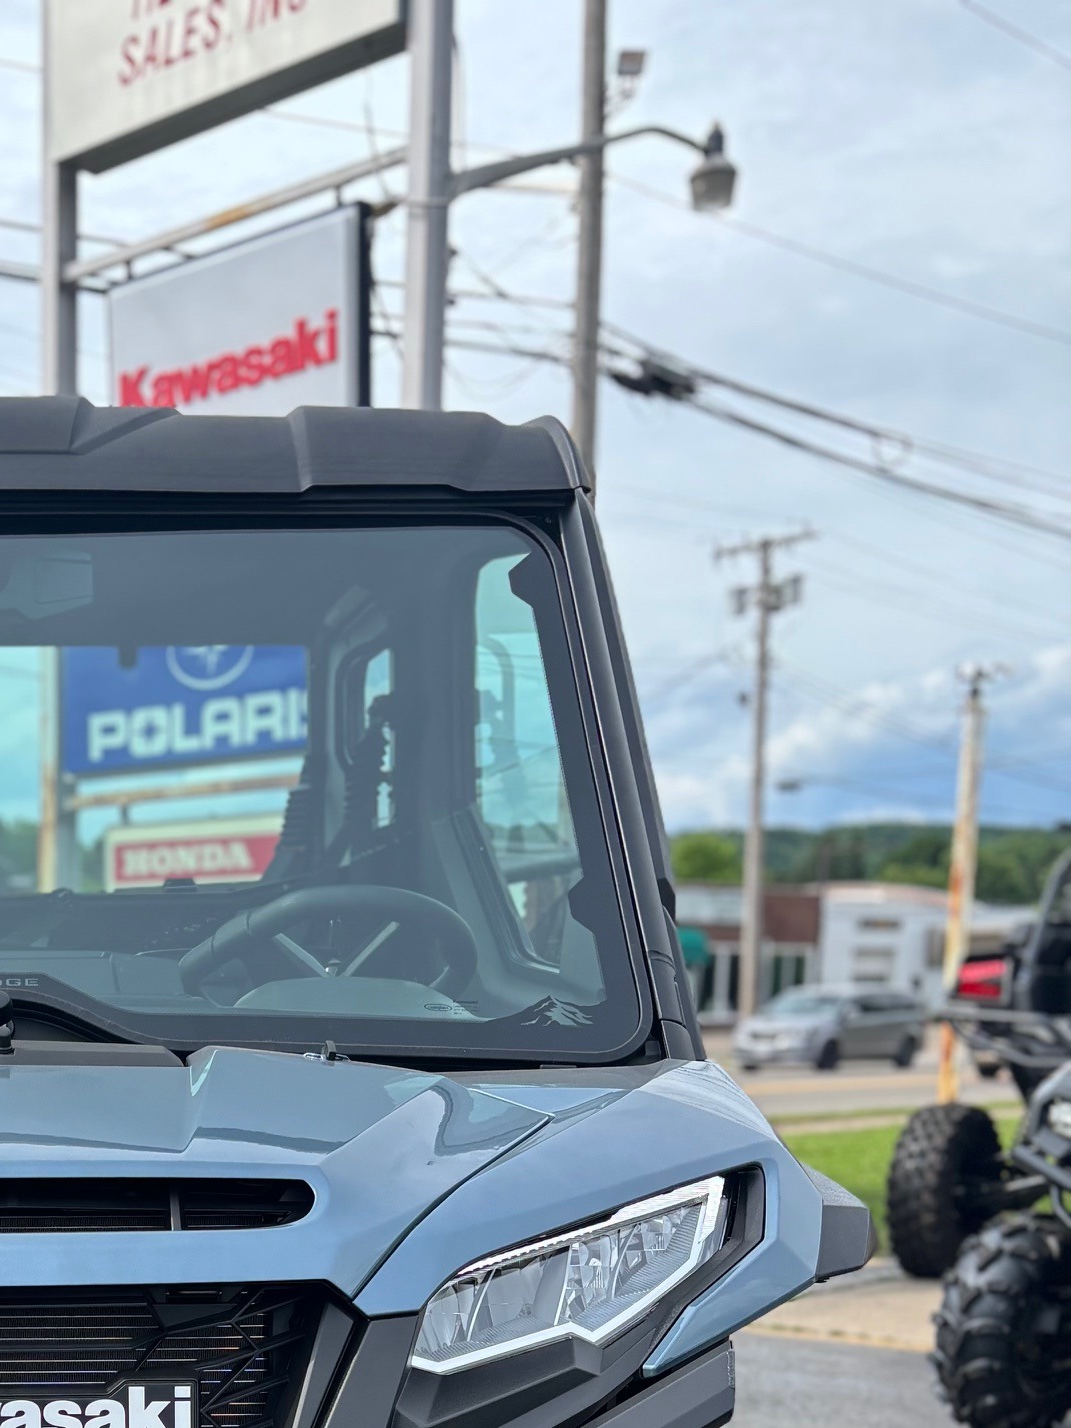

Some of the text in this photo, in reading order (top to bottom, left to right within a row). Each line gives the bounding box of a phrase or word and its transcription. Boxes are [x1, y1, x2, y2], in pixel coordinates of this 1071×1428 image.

[119, 309, 338, 408] Kawasaki
[87, 686, 308, 763] POLARI
[123, 841, 254, 876] HONDA
